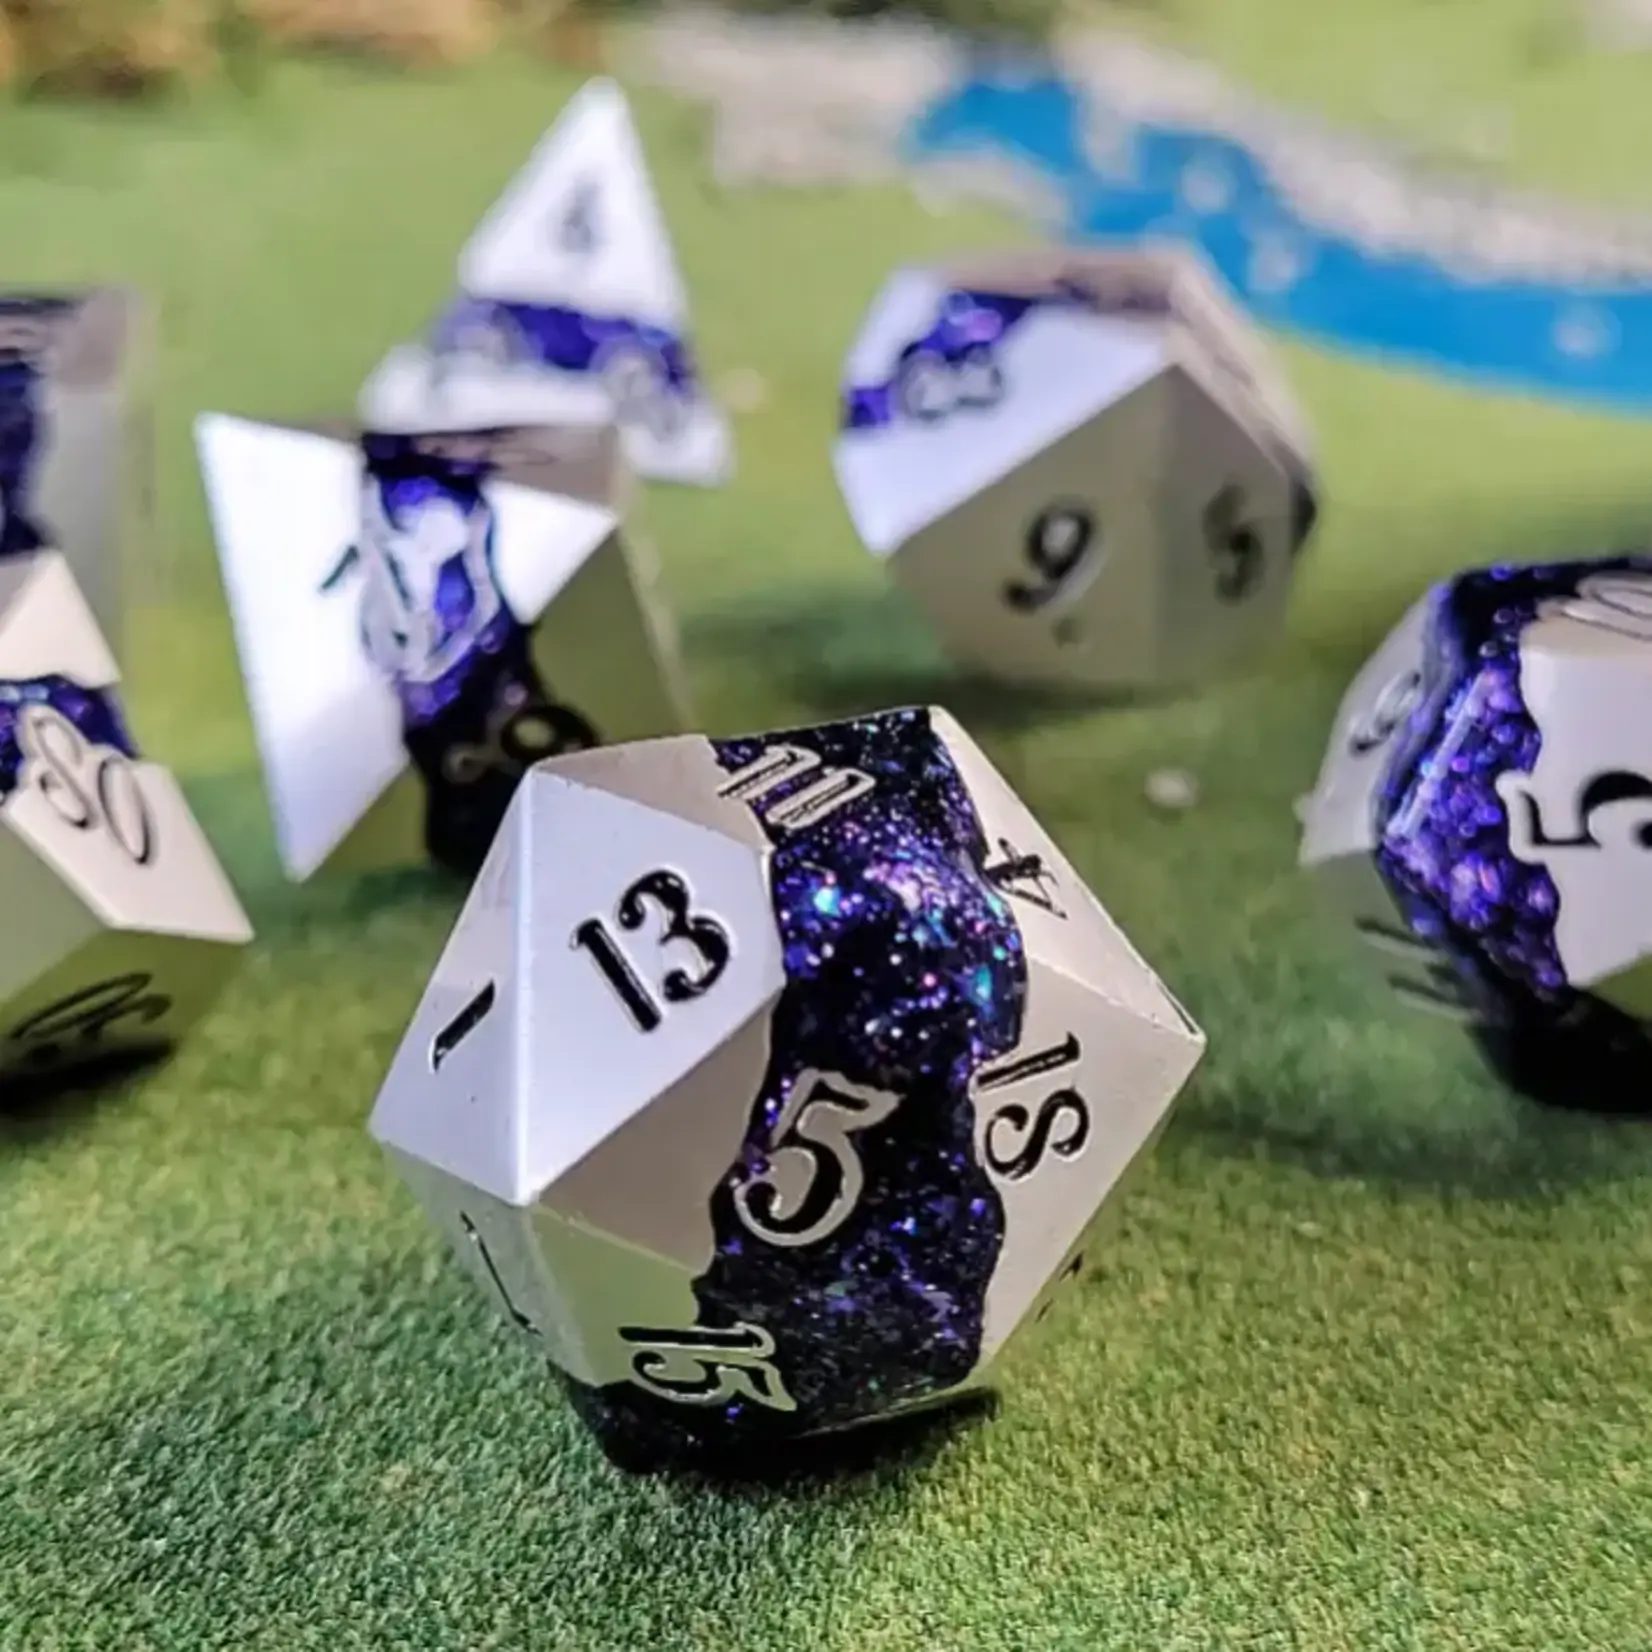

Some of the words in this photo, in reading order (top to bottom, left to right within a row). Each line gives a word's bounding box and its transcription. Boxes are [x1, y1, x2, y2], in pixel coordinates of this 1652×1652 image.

[571, 868, 734, 1034] 13
[736, 1067, 902, 1246] 5
[970, 1031, 1092, 1182] 18
[617, 1321, 797, 1412] 15
